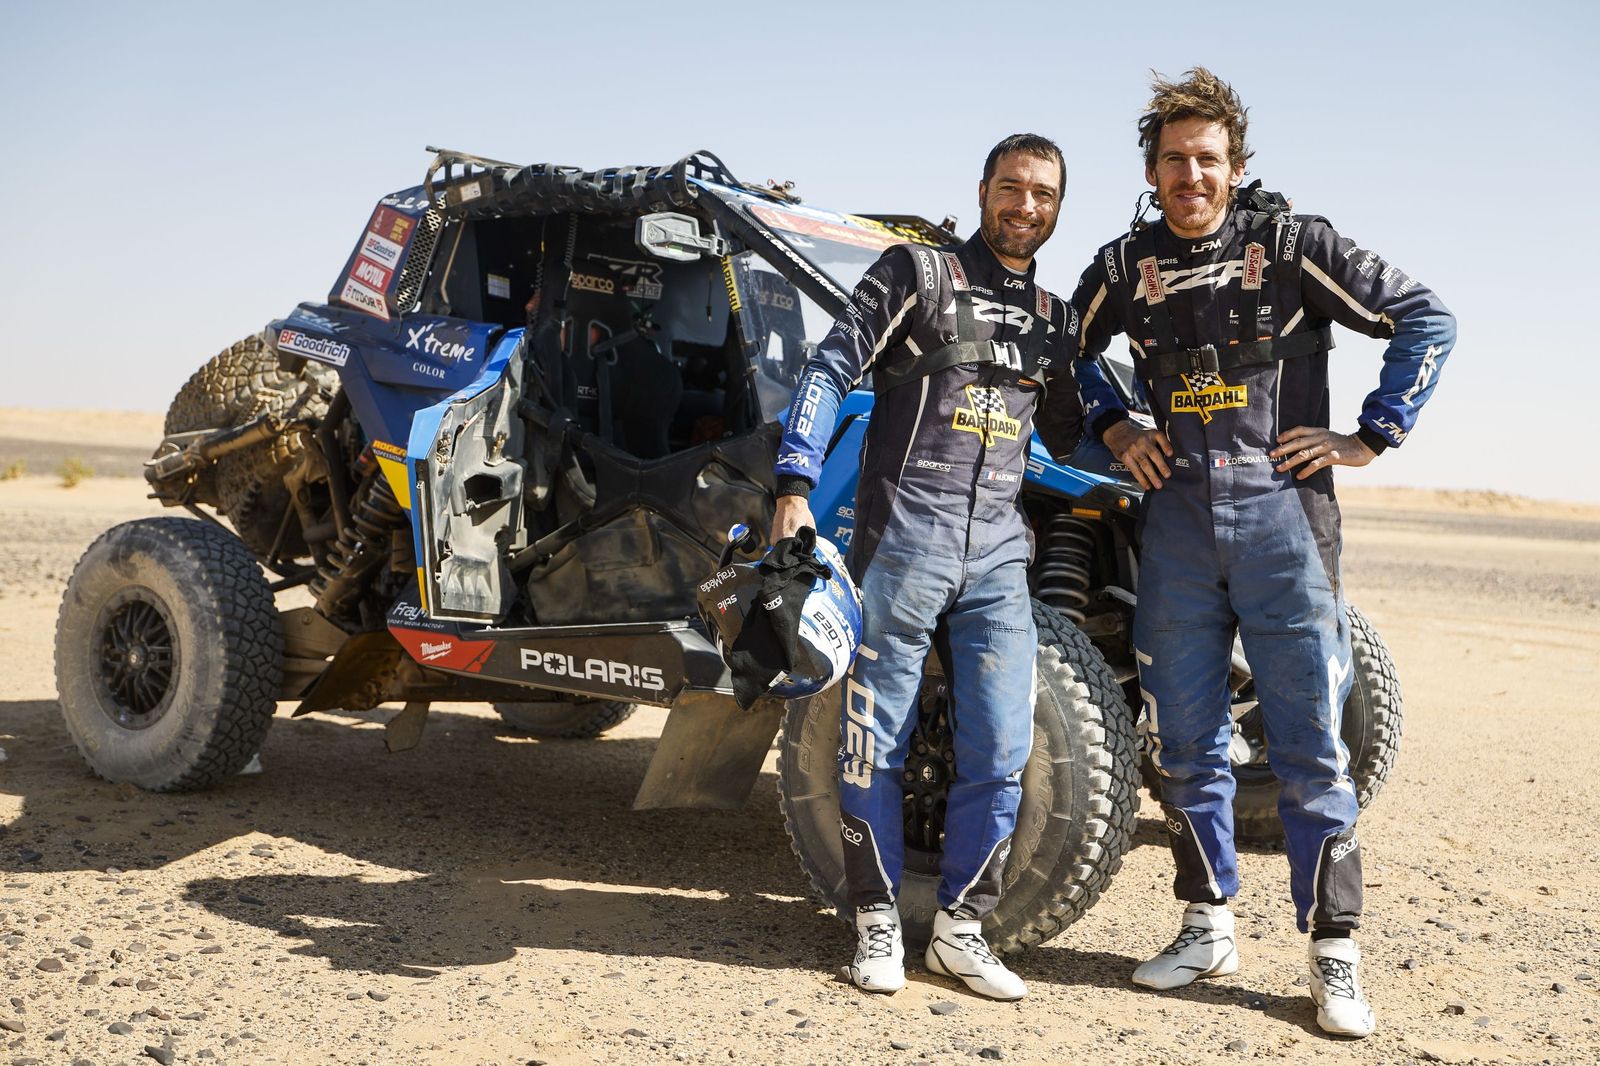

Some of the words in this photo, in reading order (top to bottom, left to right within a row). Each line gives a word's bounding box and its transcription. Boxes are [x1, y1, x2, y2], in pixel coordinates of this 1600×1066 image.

[1191, 238, 1222, 253] LFM
[1283, 221, 1300, 261] sparco
[917, 250, 934, 290] sparco
[1104, 246, 1119, 283] sparco
[1157, 257, 1178, 266] ARIS
[356, 261, 385, 288] MOTUL
[572, 273, 614, 294] sparco
[863, 273, 890, 295] LARIS
[1003, 277, 1026, 290] LFM
[1144, 264, 1160, 298] SIMPSON
[971, 285, 993, 296] ARIS
[280, 329, 348, 359] BFGoodrich
[405, 324, 475, 362] X'treme
[412, 362, 446, 379] COLOR
[796, 371, 826, 437] LOEB
[1174, 391, 1243, 408] BARDAHL
[957, 412, 1017, 436] BARDAHL
[916, 460, 951, 472] sparco
[717, 593, 738, 611] stilo
[813, 611, 843, 650] LOEB
[520, 647, 665, 690] POLARIS
